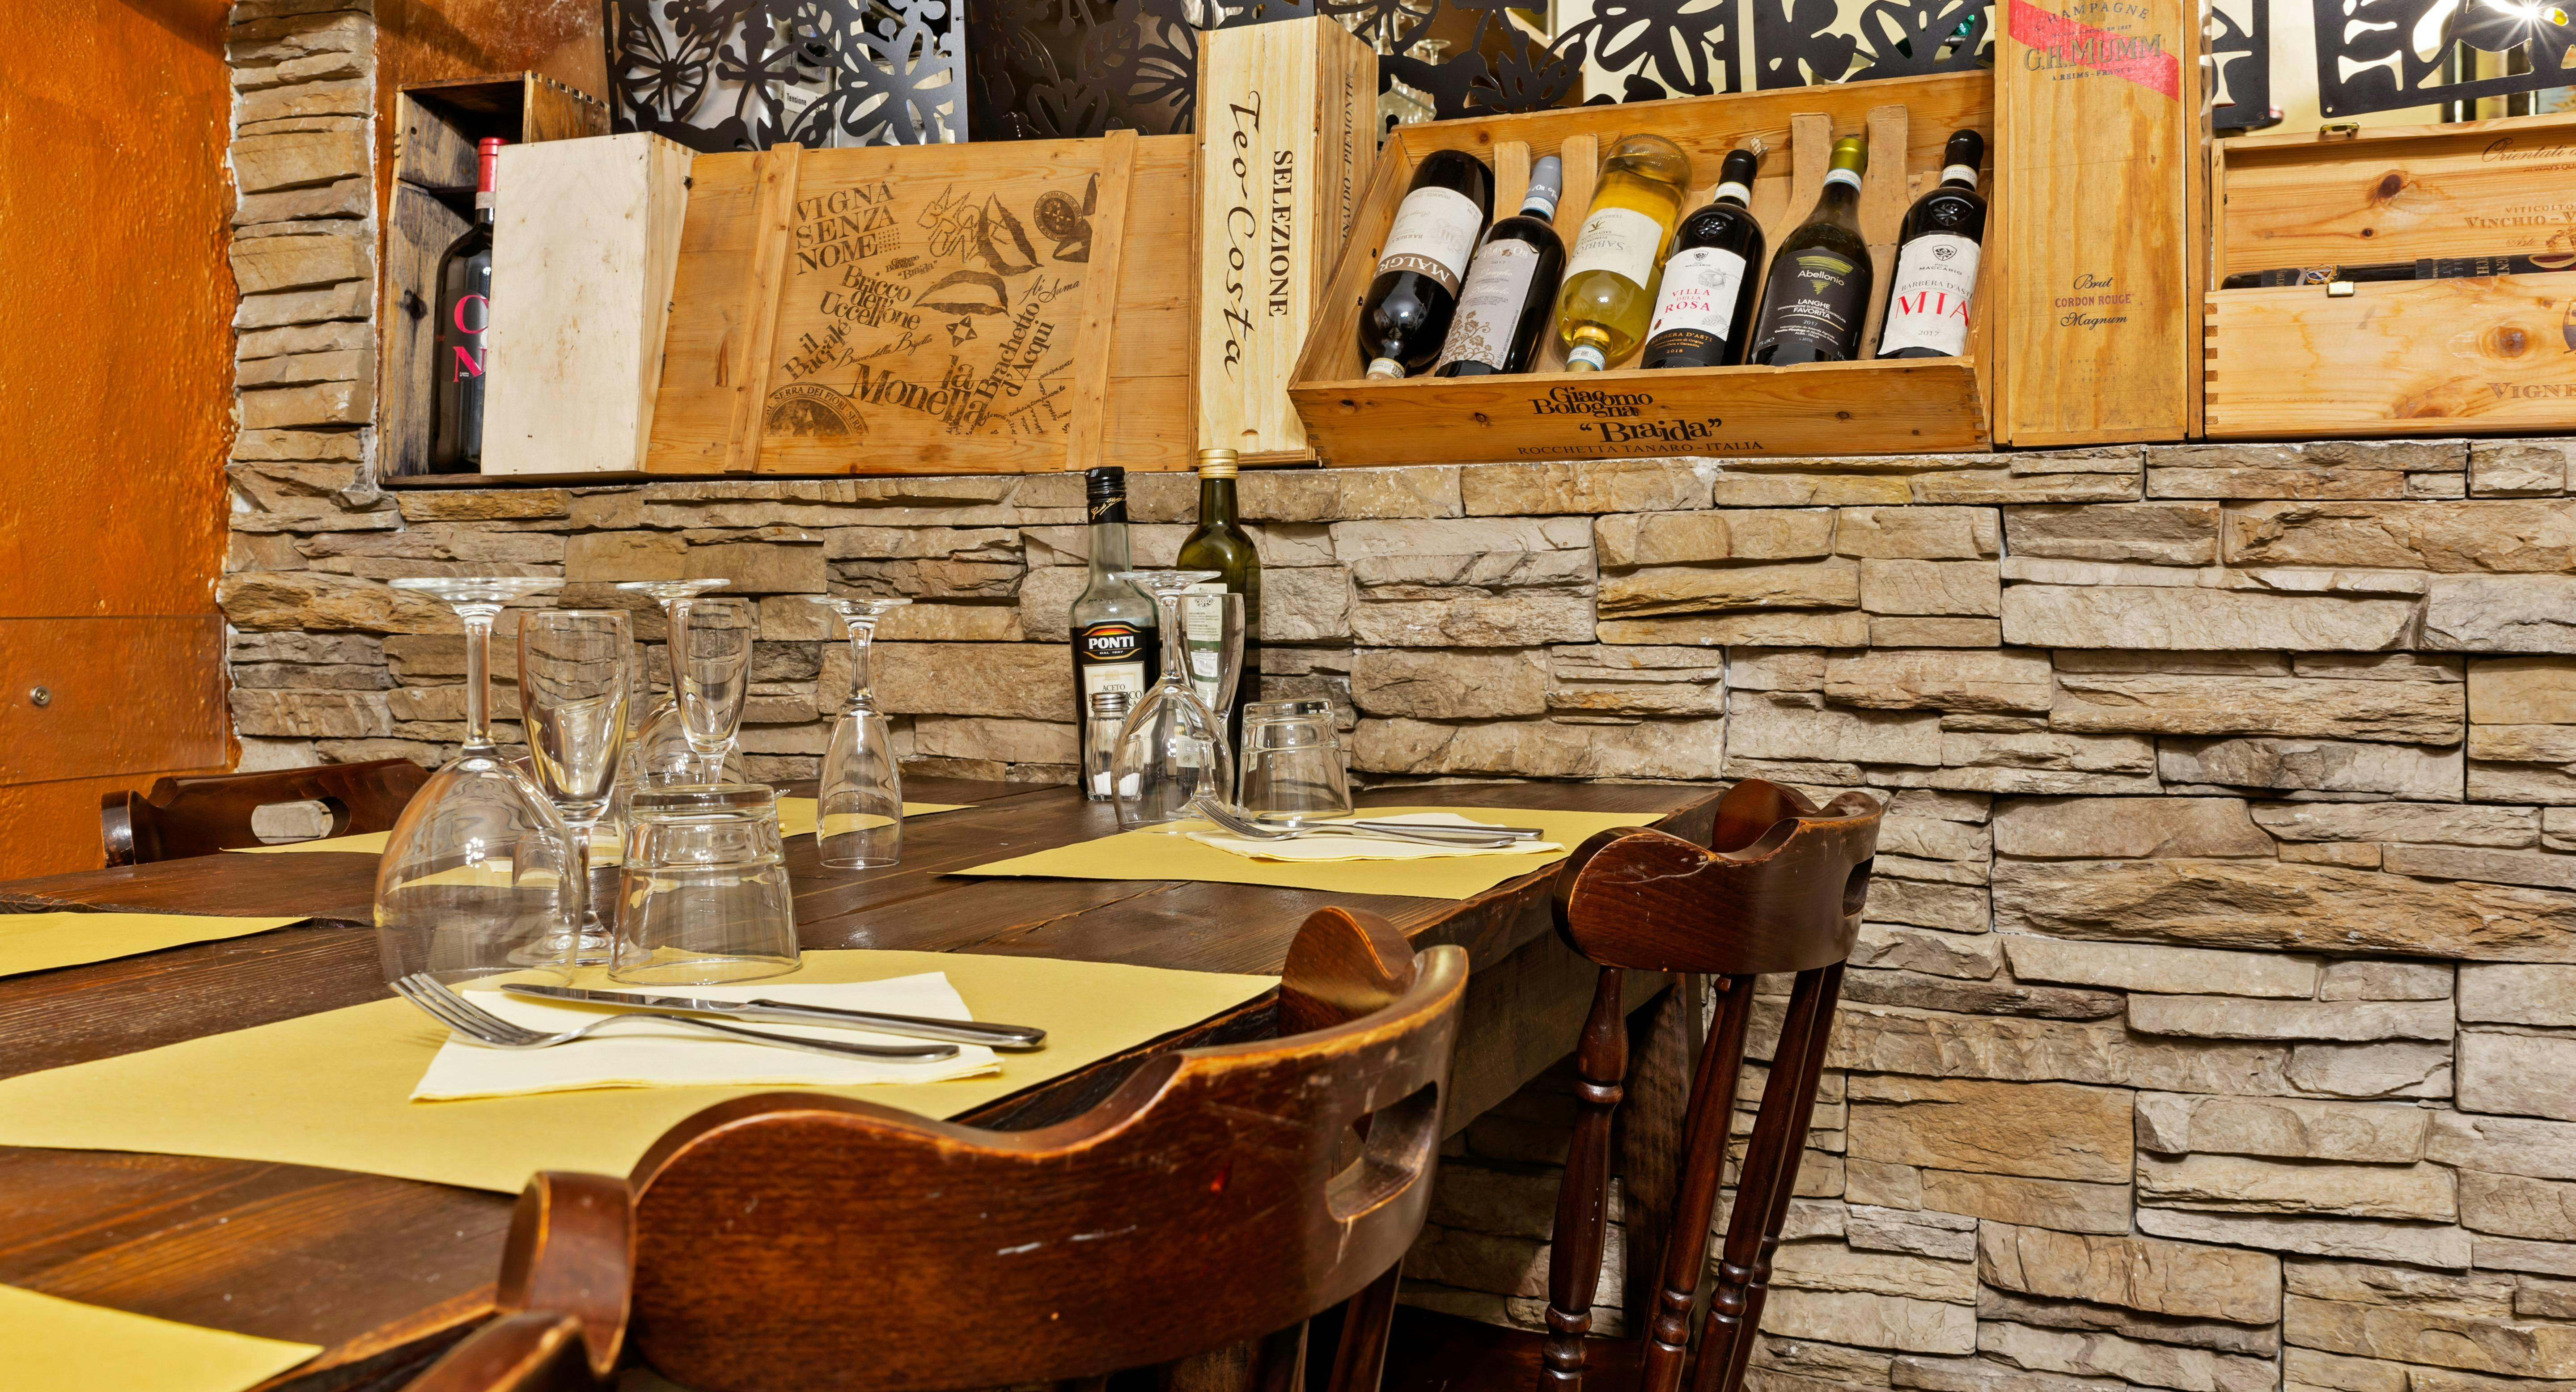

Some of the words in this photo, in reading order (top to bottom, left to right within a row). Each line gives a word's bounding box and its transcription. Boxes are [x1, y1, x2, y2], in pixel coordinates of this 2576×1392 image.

[2036, 2, 2149, 31] CHAMPAGNE
[787, 93, 807, 106] Tensione
[1344, 77, 1353, 165] PIEMONTE
[1229, 90, 1261, 200] Teo
[2482, 138, 2567, 162] Orientati
[797, 181, 897, 222] VIGNA
[1342, 178, 1351, 239] INALDO
[796, 205, 898, 250] SENZA
[2464, 215, 2546, 229] VINCHIO
[1269, 150, 1293, 317] SELEZIONE
[795, 233, 878, 275] NOME
[891, 255, 919, 266] Giacomo
[886, 261, 915, 272] Bologna
[1373, 256, 1450, 283] MALGR
[1919, 267, 1962, 275] MACCARIO
[838, 264, 911, 302] Bricco
[1797, 270, 1844, 286] Abellonio
[1901, 280, 1943, 291] BARBERA
[2073, 274, 2114, 290] Brut
[1017, 274, 1045, 305] Ai
[1224, 206, 1256, 384] Costa
[1672, 289, 1710, 297] VILLA
[1664, 301, 1710, 314] ROSA
[1798, 299, 1831, 310] LANGHE
[1895, 291, 1969, 327] MIA
[2055, 296, 2095, 308] CORDON
[2098, 294, 2131, 305] ROUGE
[1793, 308, 1830, 319] FAVORITA
[2060, 312, 2128, 330] Magnum
[1686, 332, 1712, 342] D'ASTI
[973, 303, 1040, 402] Brachetto
[939, 354, 976, 392] la
[845, 363, 988, 426] Monella
[1549, 386, 1653, 406] Giacomo
[2487, 382, 2576, 399] VIGNE
[774, 386, 804, 402] SERRA
[807, 386, 824, 397] DEI
[824, 392, 847, 411] FIORI
[847, 410, 865, 436] SERRA
[1528, 398, 1639, 418] Bologna
[1517, 445, 1618, 455] ROCCHETTA
[1621, 444, 1693, 453] TANARO
[1706, 441, 1764, 451] ITALIA
[1089, 635, 1135, 650] PONTI
